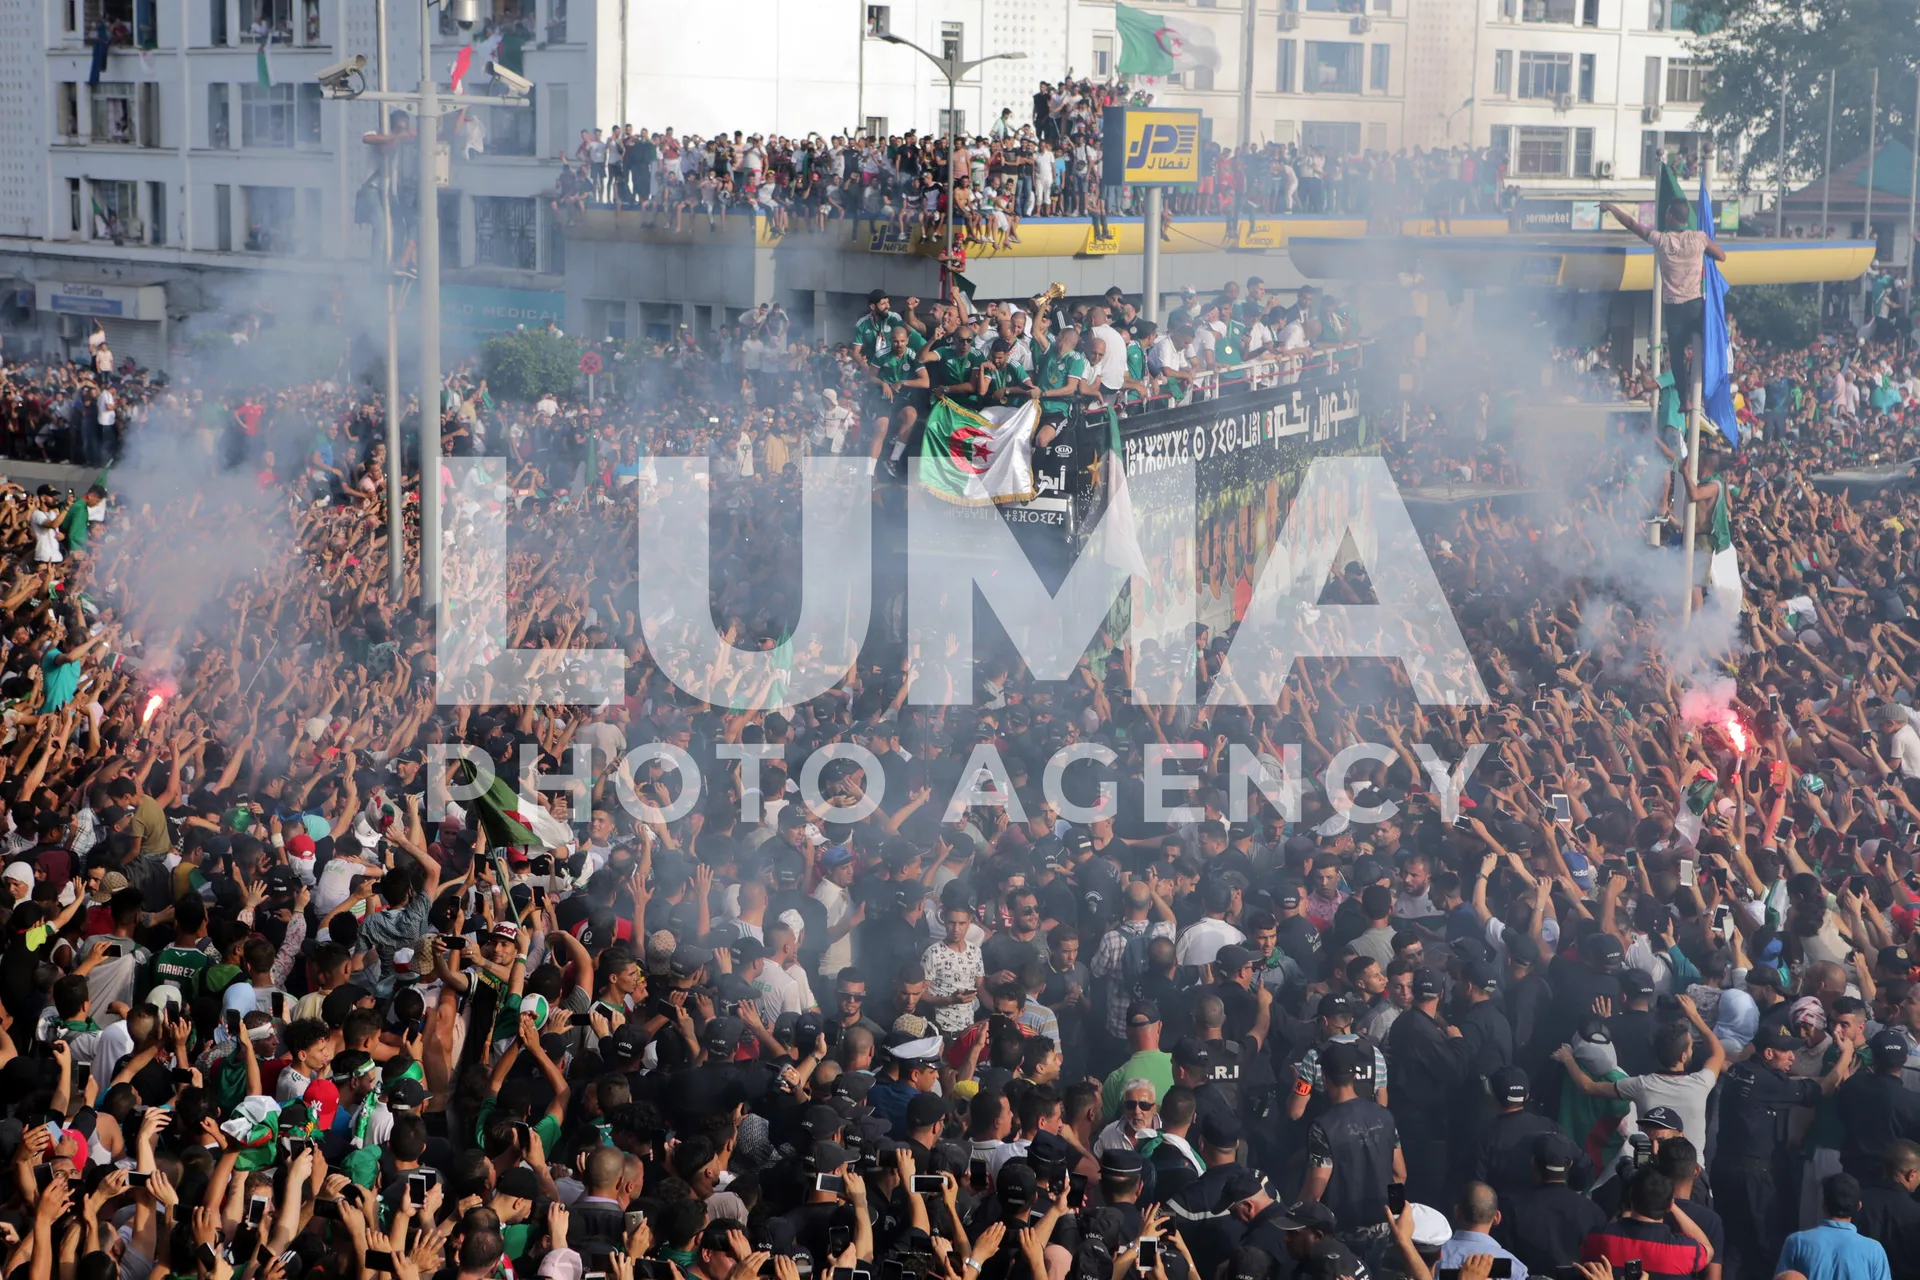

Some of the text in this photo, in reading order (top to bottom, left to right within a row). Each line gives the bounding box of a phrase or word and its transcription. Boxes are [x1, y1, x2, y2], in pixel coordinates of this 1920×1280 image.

[483, 304, 562, 322] MEDICAL
[157, 963, 196, 980] MAHREZ
[1207, 1064, 1240, 1080] .R.I
[1085, 1232, 1104, 1242] POLICE
